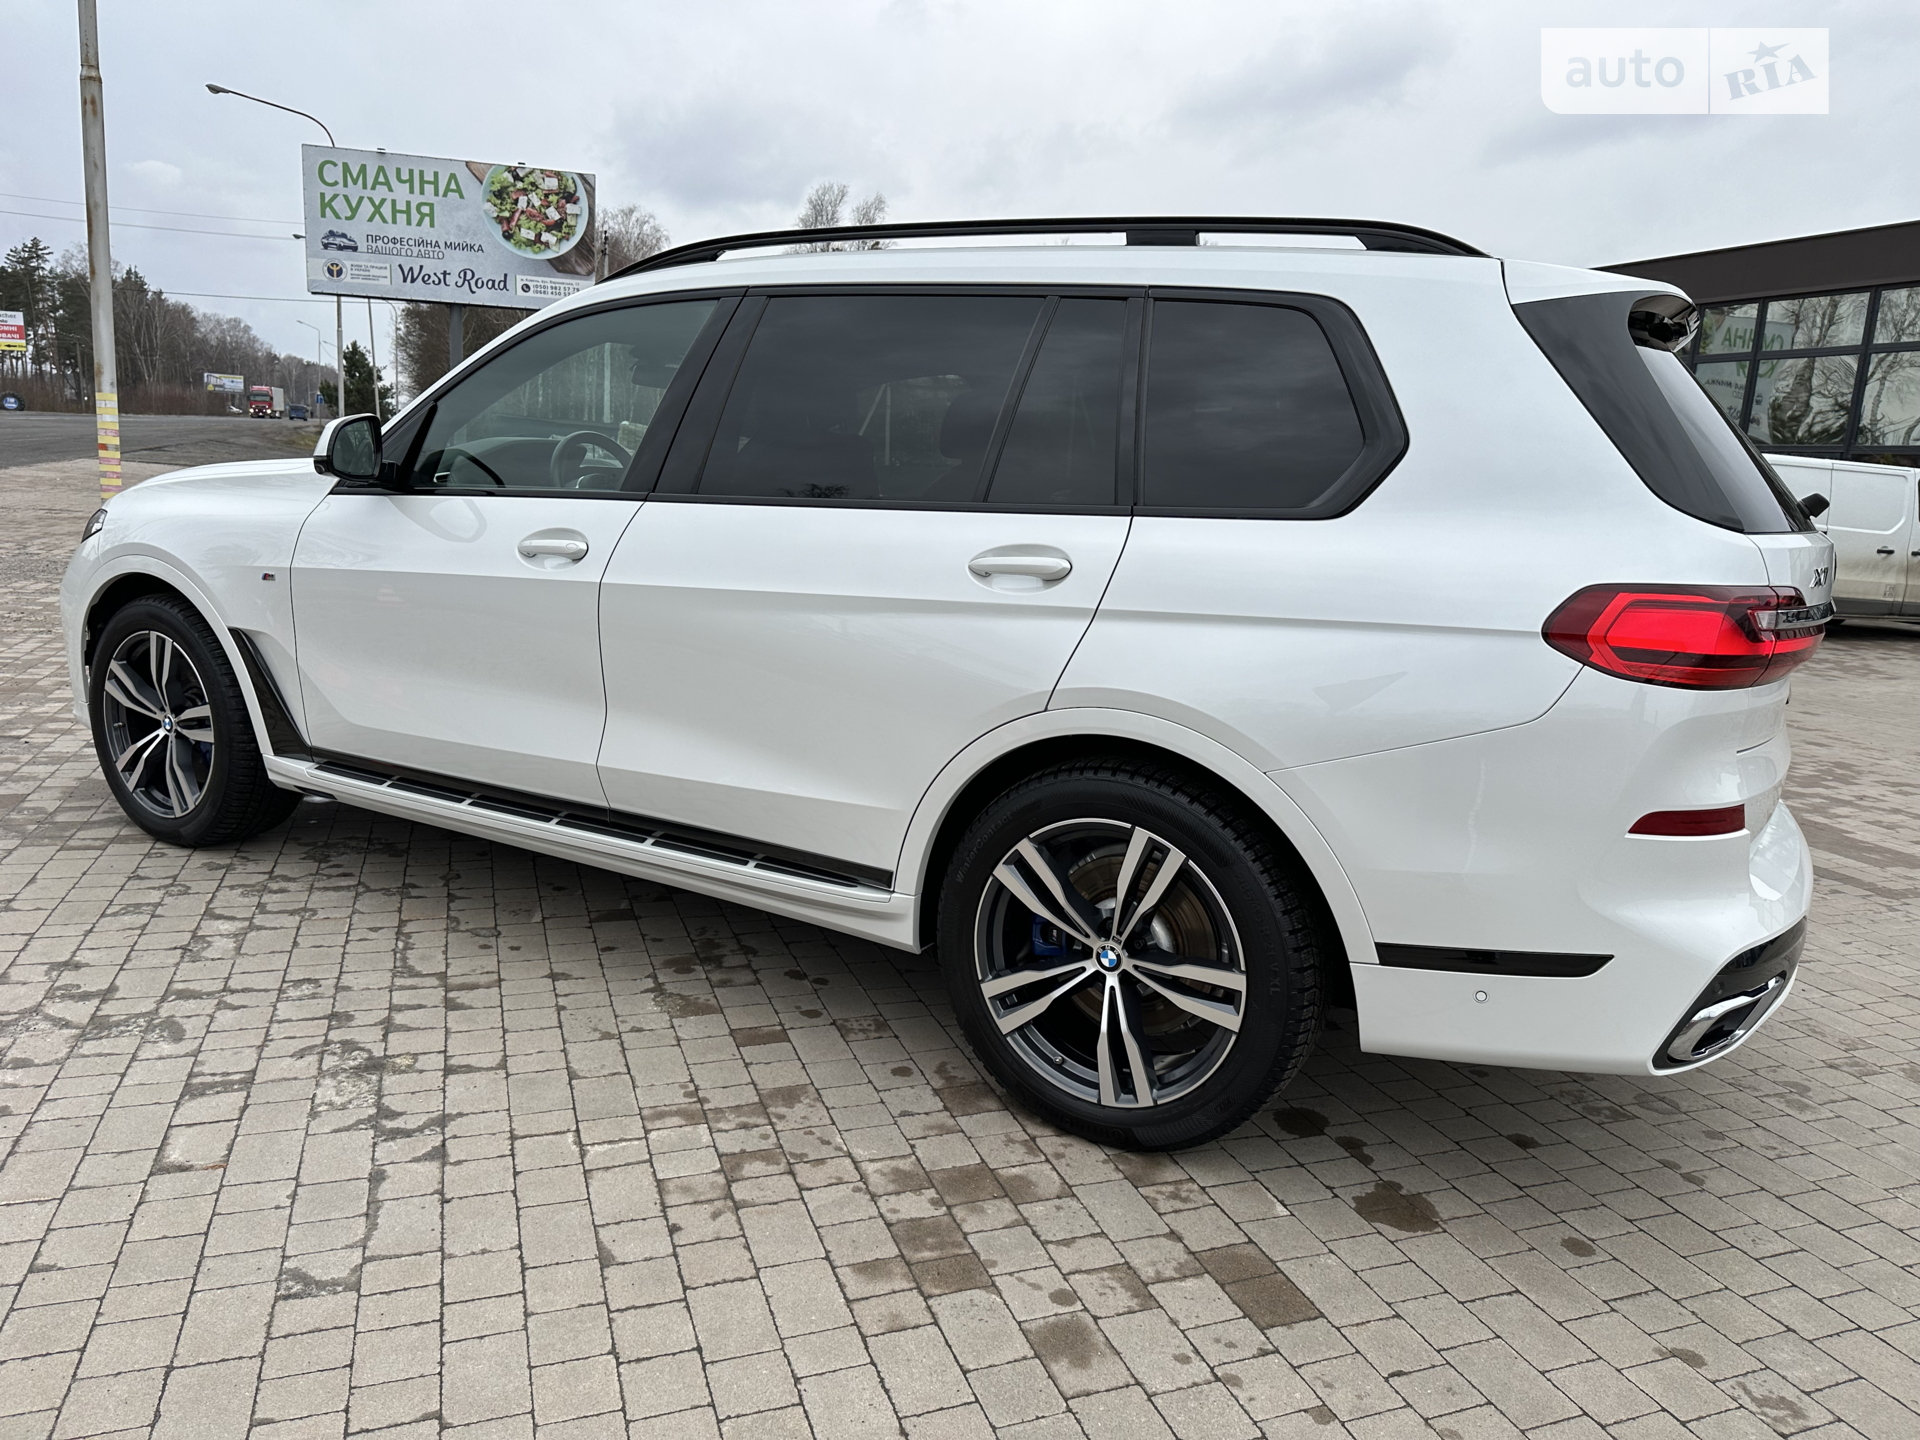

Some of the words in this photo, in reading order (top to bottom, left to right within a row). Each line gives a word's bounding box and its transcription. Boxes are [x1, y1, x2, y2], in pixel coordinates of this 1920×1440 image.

[317, 160, 465, 199] СМАЧНА
[319, 192, 435, 228] КУХНЯ
[366, 234, 441, 250] ПРОФЕСІЙНА
[444, 240, 485, 254] МИЙКА
[366, 244, 413, 257] ВАШОГО
[416, 249, 445, 260] АВТО
[398, 263, 451, 287] West
[455, 268, 510, 294] Road
[955, 811, 1013, 883] WinterContact
